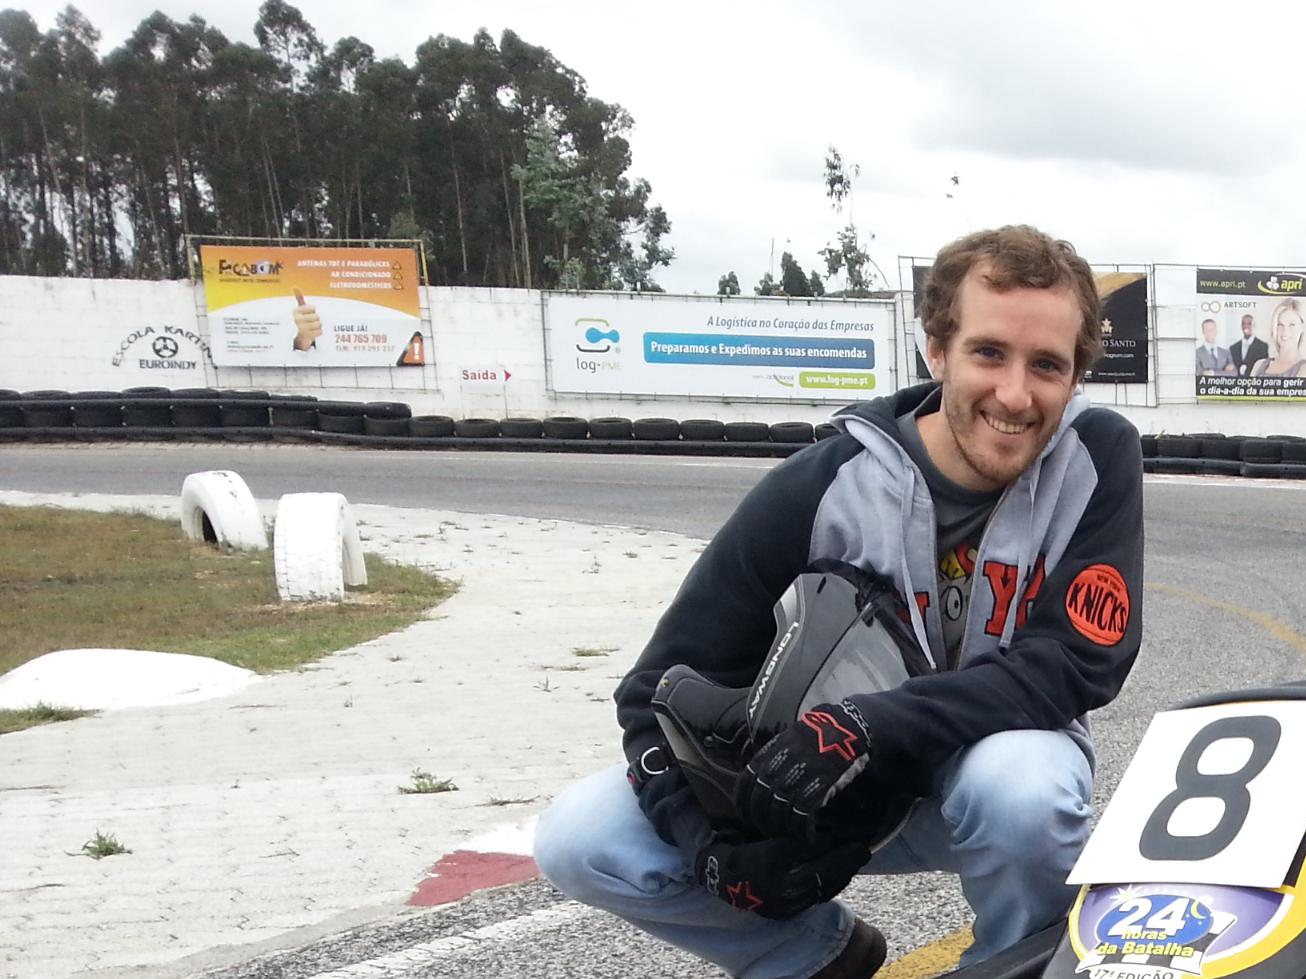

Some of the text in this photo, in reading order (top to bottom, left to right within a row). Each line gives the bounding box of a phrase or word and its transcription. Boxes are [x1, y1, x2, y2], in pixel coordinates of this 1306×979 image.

[1200, 280, 1247, 288] www.apri.pt
[1281, 278, 1303, 291] apri
[707, 316, 874, 333] A Logística no Coração das Empresas
[112, 326, 155, 367] ESCOLA
[335, 335, 351, 343] 244
[1110, 339, 1136, 347] SANTO
[650, 341, 867, 358] Preparamos e Expedimos as suas encomendas
[139, 359, 196, 369] EUROINDY
[1200, 376, 1303, 388] A melhor opção para gerir
[1208, 387, 1244, 395] dia-a-dia
[1246, 387, 1257, 395] da
[1068, 583, 1127, 633] KNICKS
[1139, 715, 1282, 861] 8
[1107, 898, 1189, 936] 24
[1096, 941, 1195, 958] da Batalha
